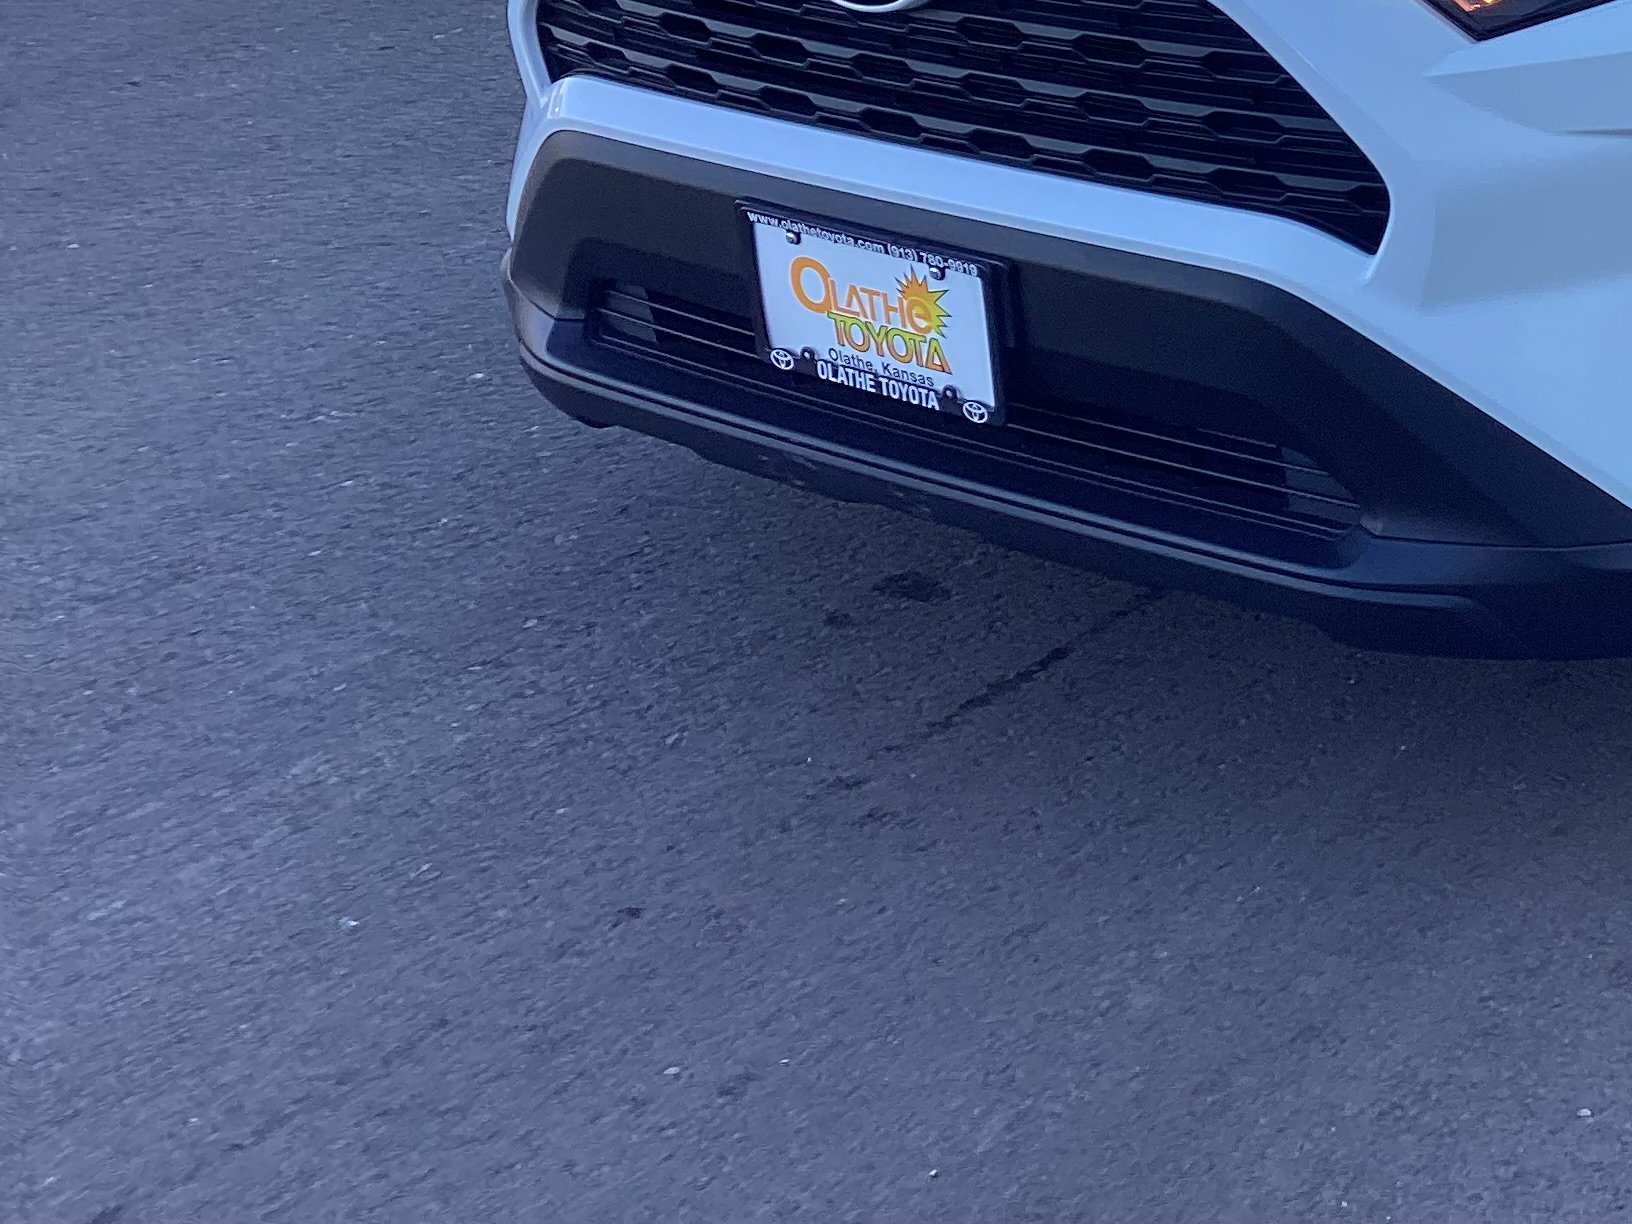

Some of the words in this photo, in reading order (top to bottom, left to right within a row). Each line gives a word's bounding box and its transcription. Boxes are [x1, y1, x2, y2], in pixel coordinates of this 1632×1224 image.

[746, 211, 886, 255] www.olathetoyota.com
[886, 243, 918, 263] (913)
[919, 252, 979, 276] 780-9919
[826, 311, 953, 376] TOYOTA
[828, 347, 878, 374] Olathe,
[881, 361, 935, 388] Kansas
[816, 359, 876, 394] OLATHE
[877, 376, 940, 411] TOYOTA
